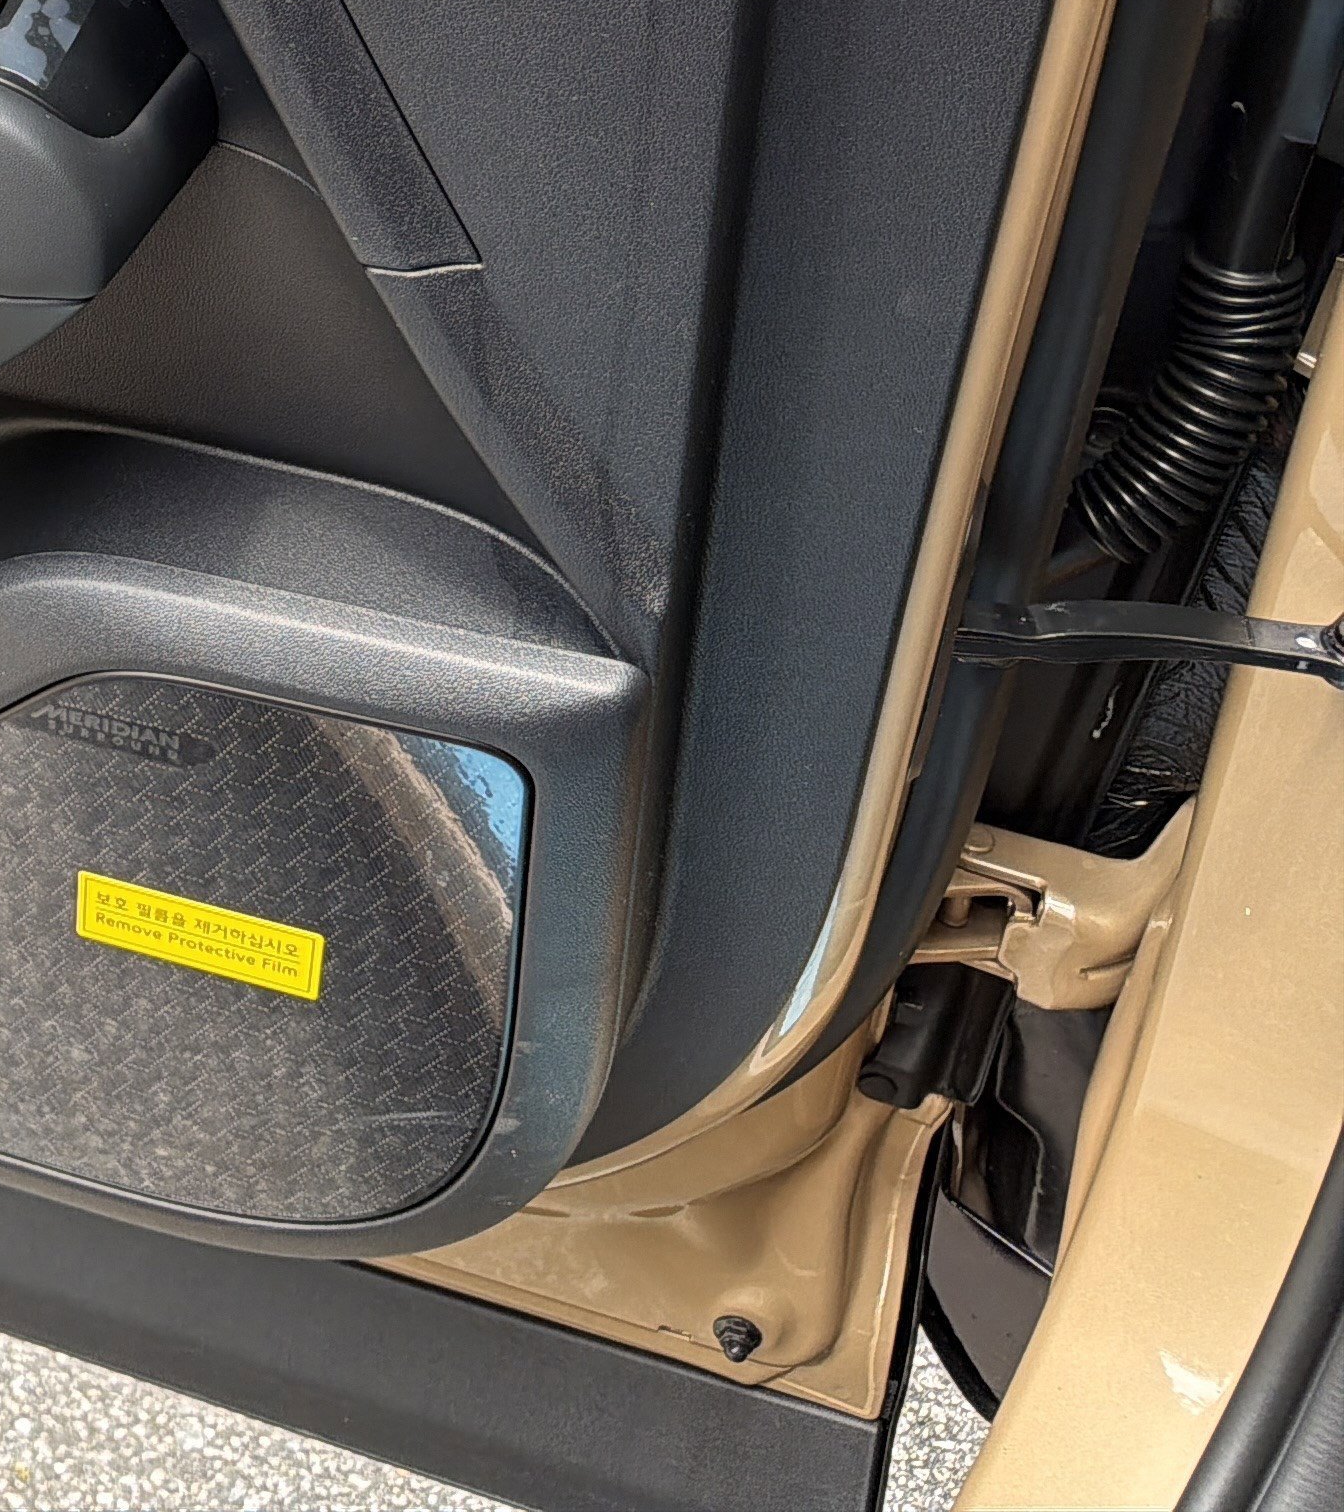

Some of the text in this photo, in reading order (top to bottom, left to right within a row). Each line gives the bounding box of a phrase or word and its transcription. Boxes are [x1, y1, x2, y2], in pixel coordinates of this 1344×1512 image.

[30, 704, 180, 750] MERIDIAN
[95, 891, 300, 958] 보호 필름을 제거하십시오
[95, 911, 298, 978] Remove Protective Film
